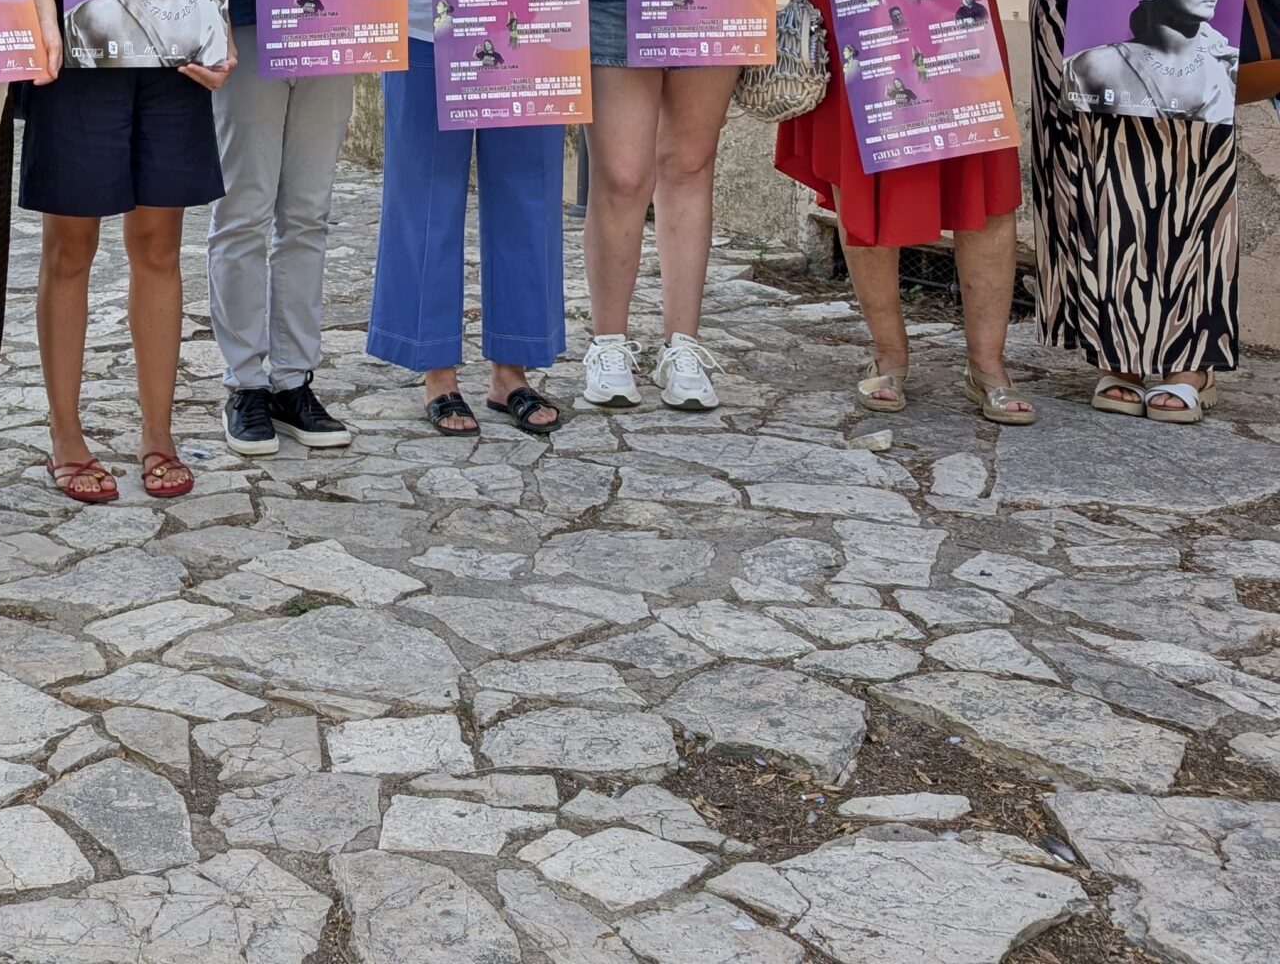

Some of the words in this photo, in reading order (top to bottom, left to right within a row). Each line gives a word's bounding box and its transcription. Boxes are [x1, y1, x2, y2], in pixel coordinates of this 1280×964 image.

[640, 47, 667, 56] rama
[270, 57, 298, 67] rama
[450, 109, 478, 119] rama
[873, 148, 900, 161] rama
